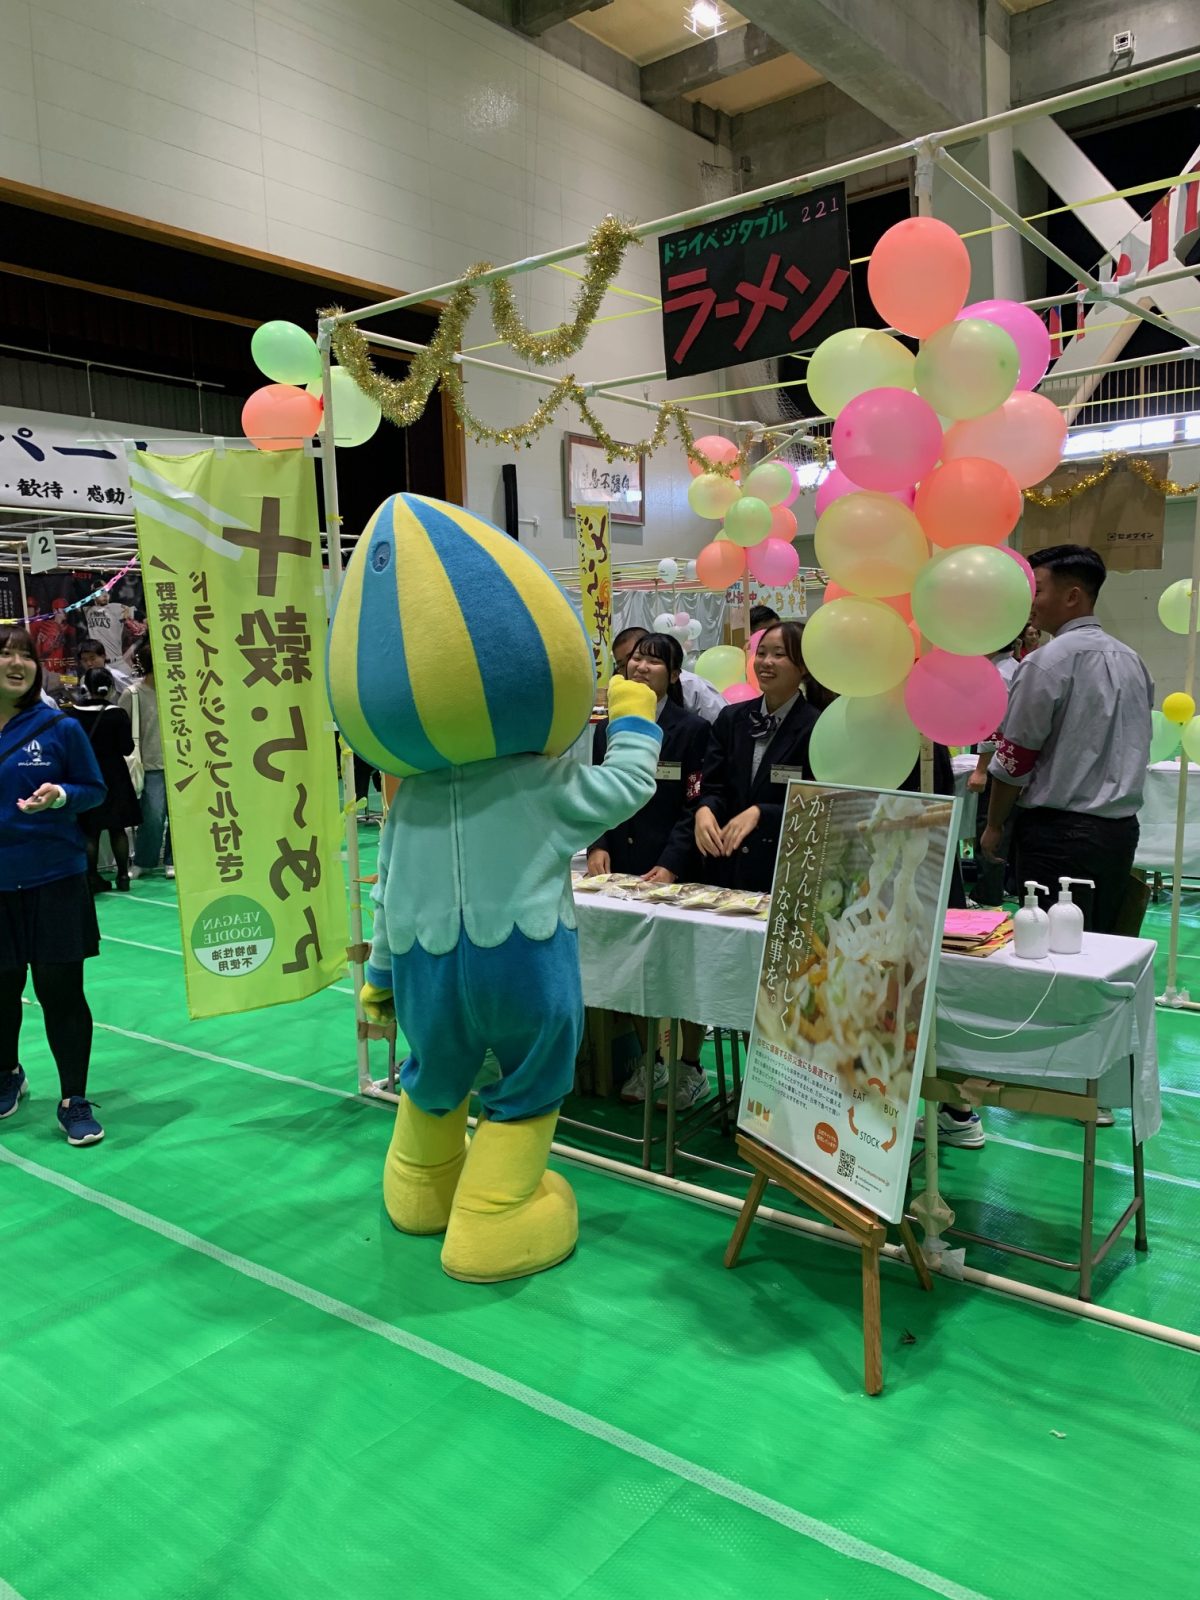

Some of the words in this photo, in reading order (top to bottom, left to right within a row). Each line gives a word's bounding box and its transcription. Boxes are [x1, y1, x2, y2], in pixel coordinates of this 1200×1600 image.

[664, 207, 789, 265] ドライベジタブル
[663, 253, 850, 365] ラーメン
[0, 427, 148, 462] ペー
[38, 536, 51, 554] 2
[765, 793, 806, 1004] ヘルシーな食事を。
[780, 794, 825, 1031] かんたんにおいしく
[852, 1089, 867, 1102] EAT
[883, 1103, 899, 1118] BUY
[859, 1131, 881, 1150] STOCK
